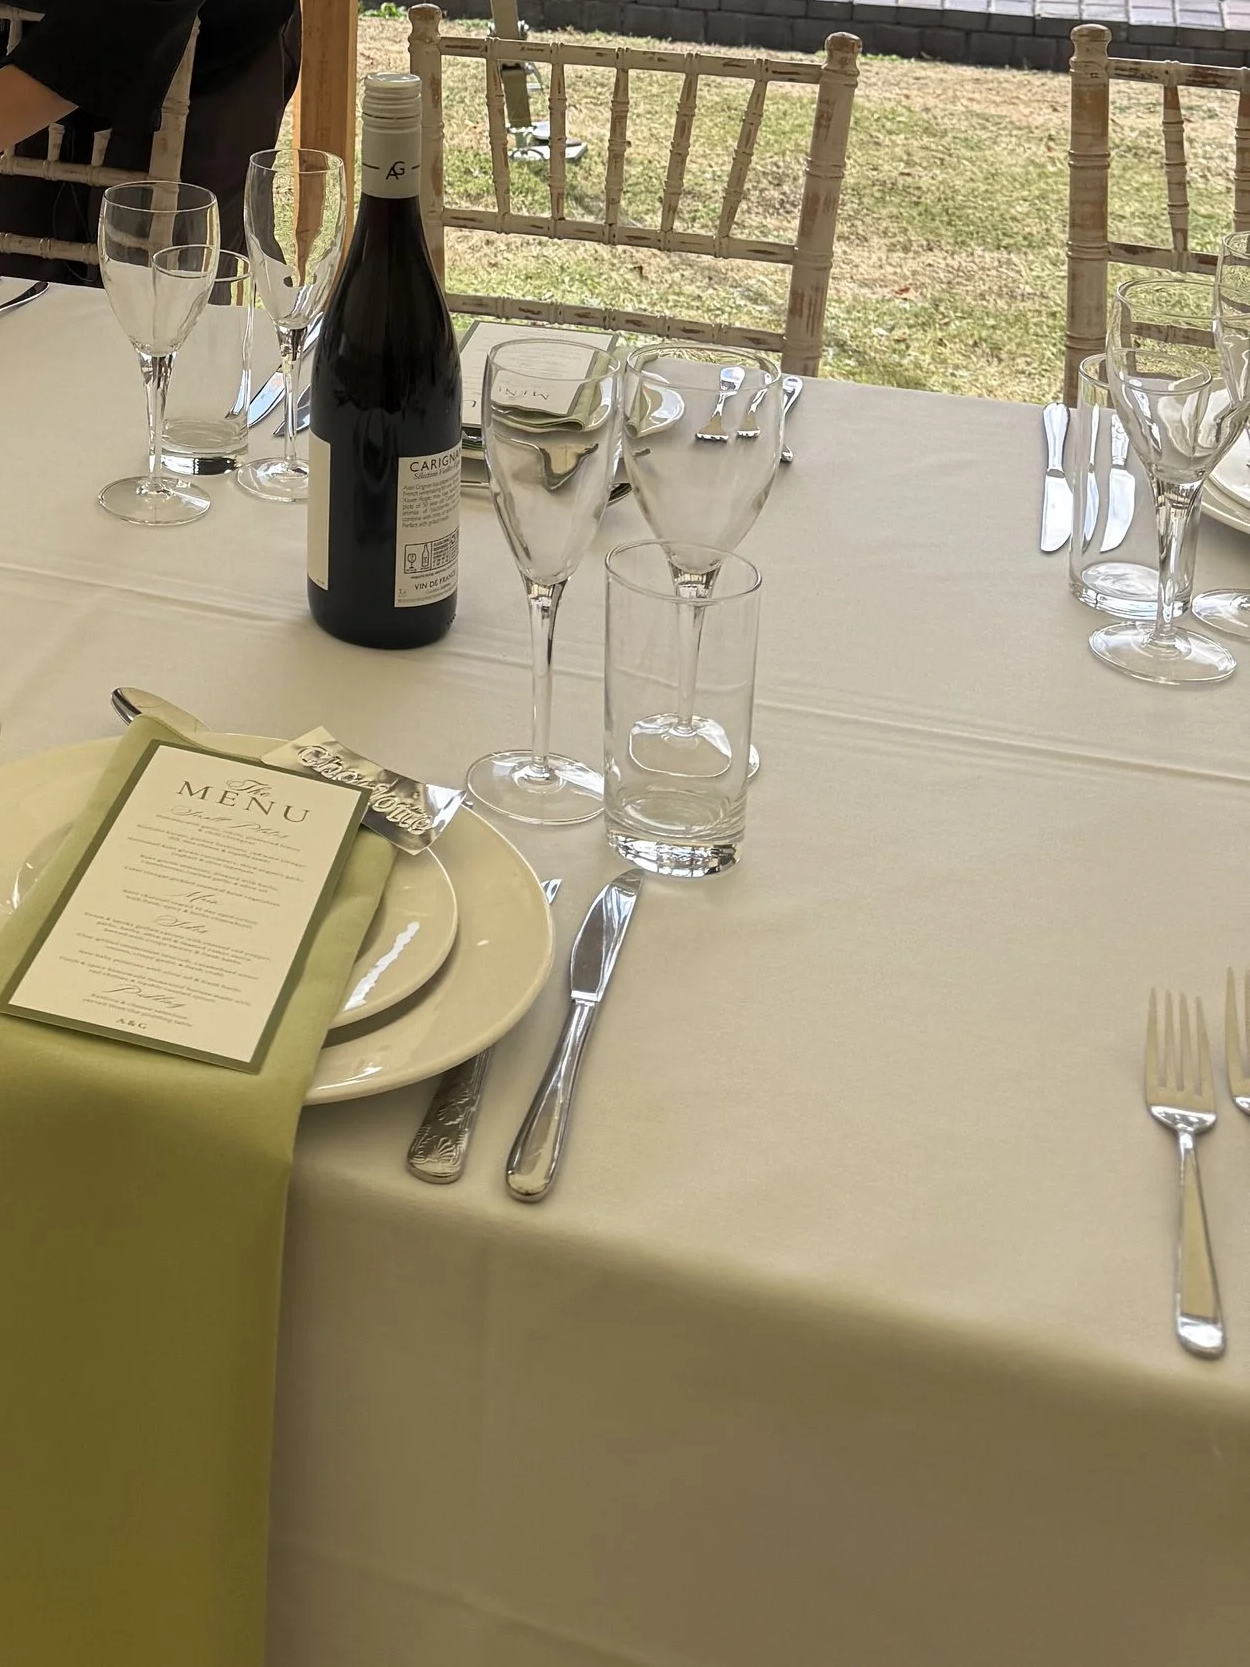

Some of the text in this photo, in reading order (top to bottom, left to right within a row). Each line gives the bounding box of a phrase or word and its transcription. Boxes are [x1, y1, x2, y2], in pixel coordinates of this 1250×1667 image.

[177, 781, 310, 823] MENU
[226, 780, 272, 797] The
[298, 745, 432, 835] Charlotte
[170, 805, 288, 839] Small Plates
[152, 915, 209, 934] Sides
[102, 984, 186, 1009] Pudding
